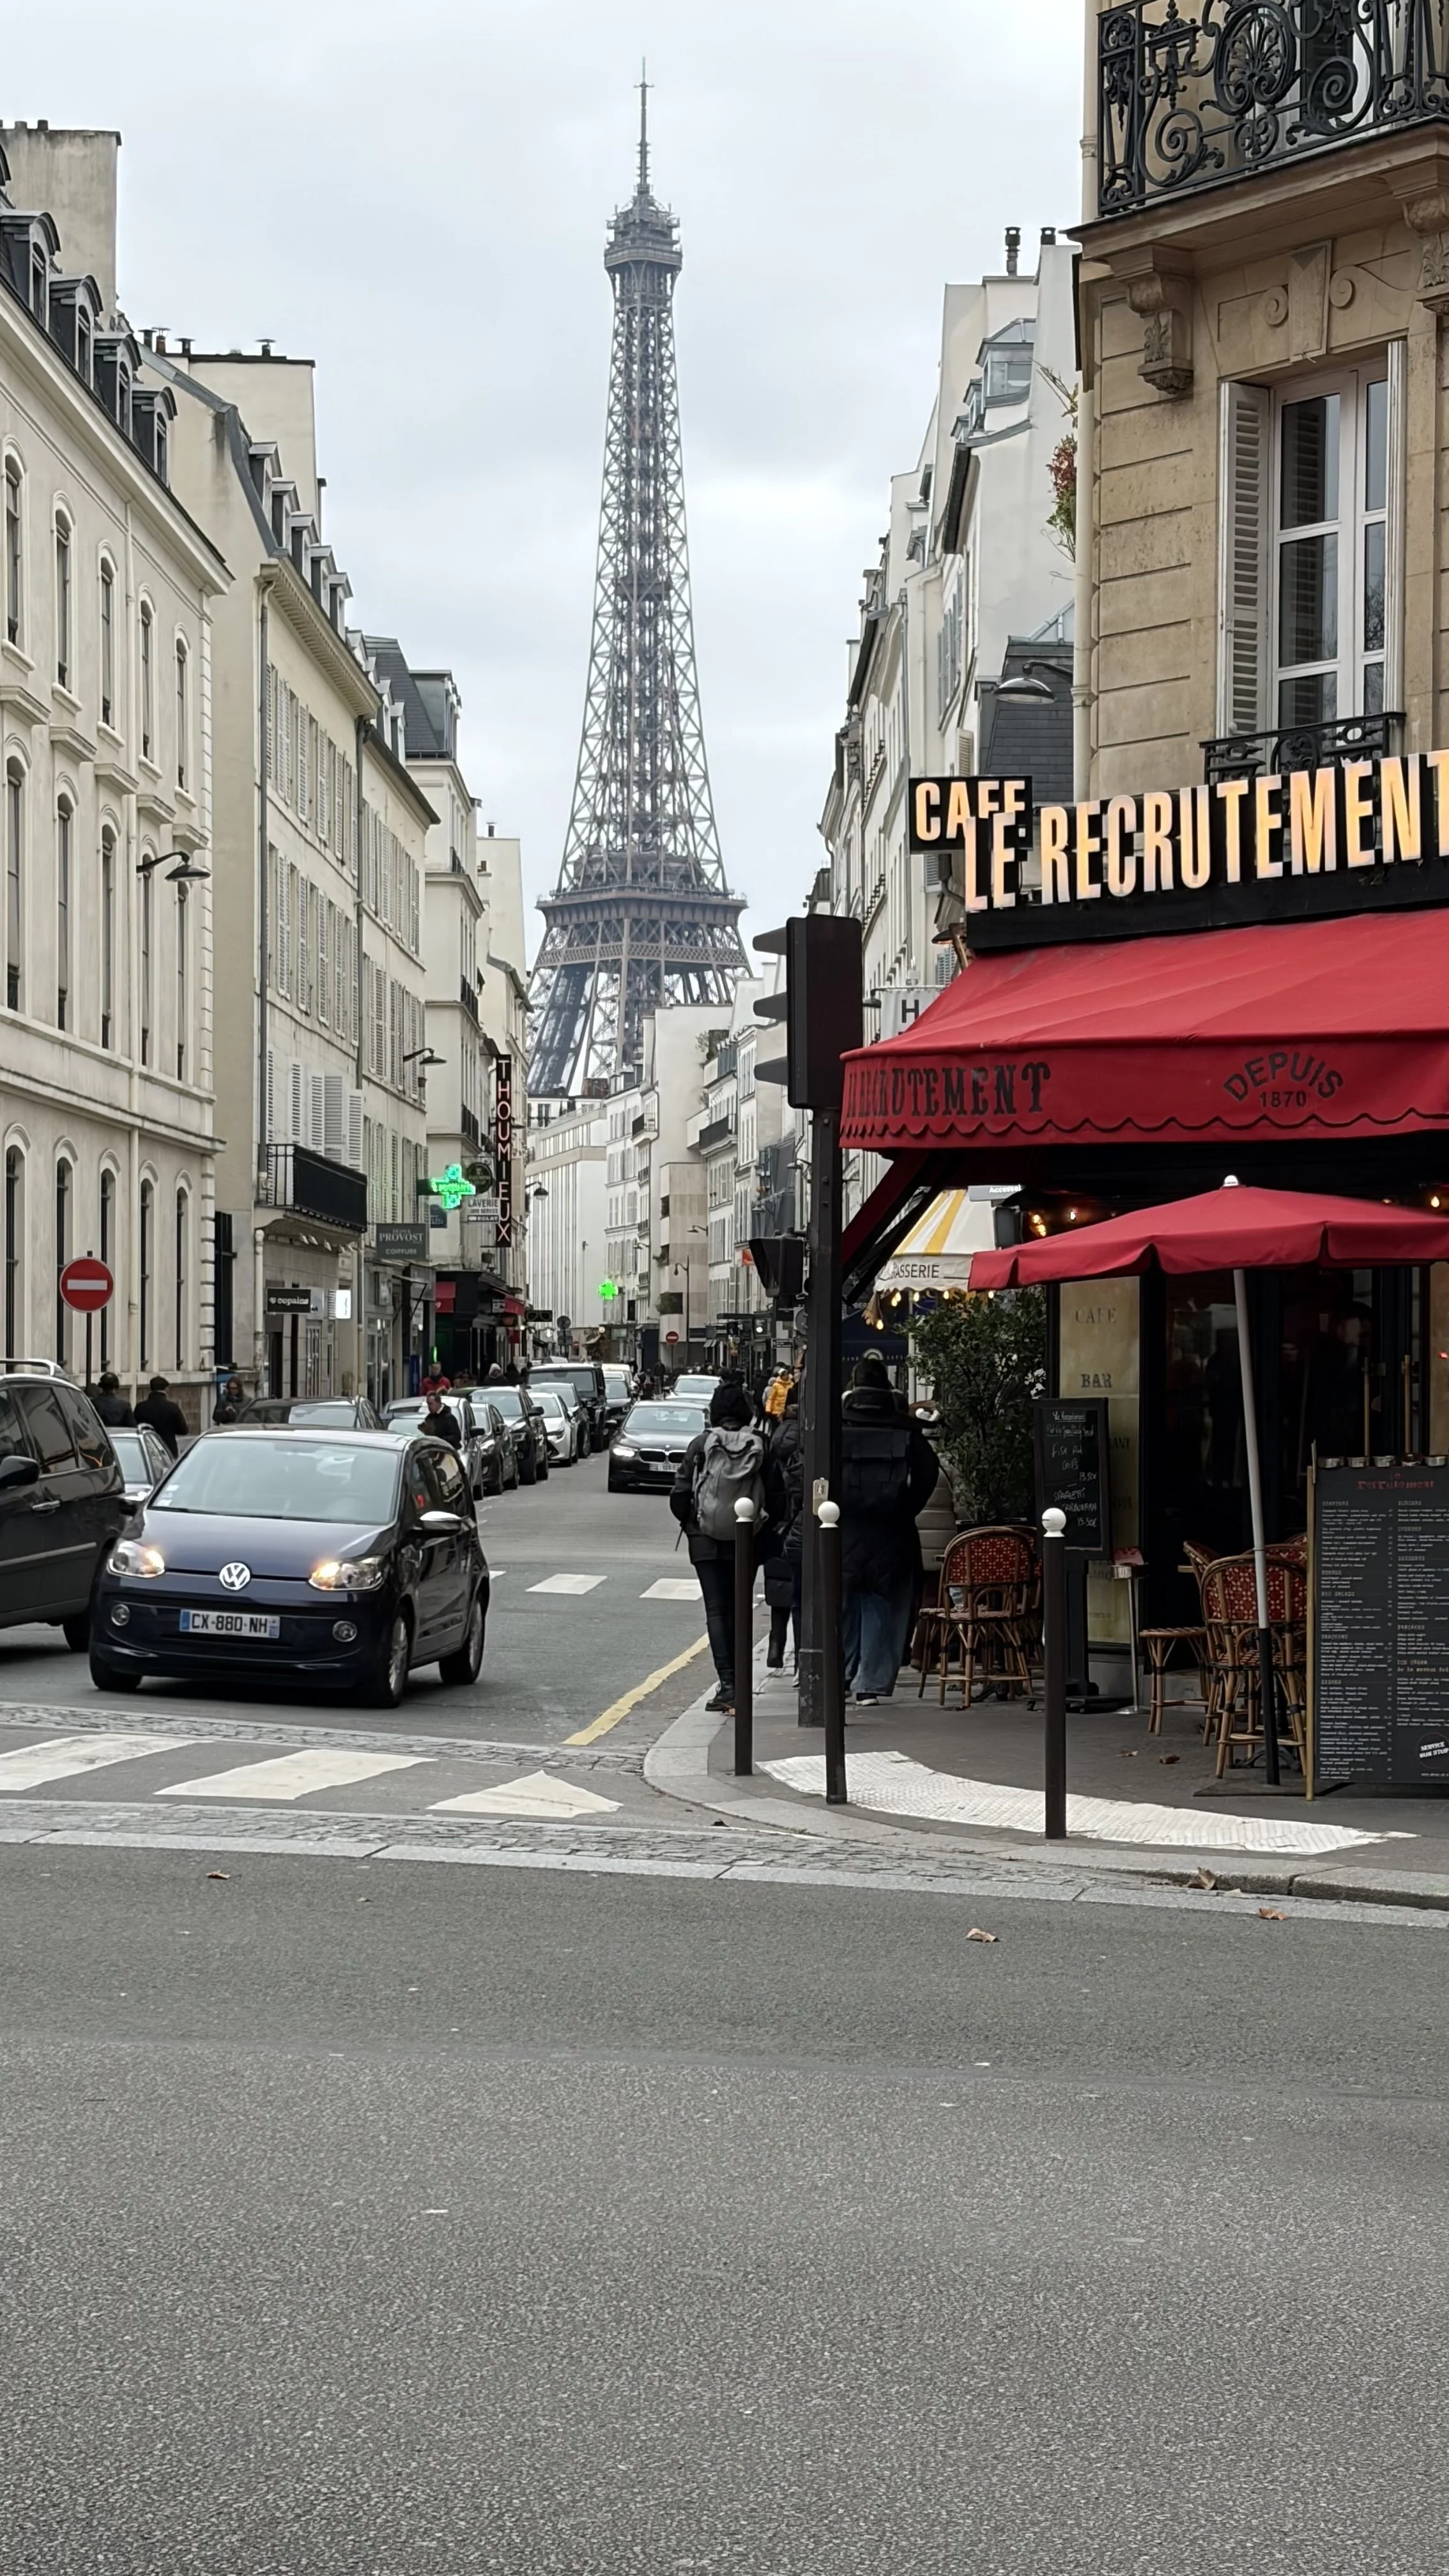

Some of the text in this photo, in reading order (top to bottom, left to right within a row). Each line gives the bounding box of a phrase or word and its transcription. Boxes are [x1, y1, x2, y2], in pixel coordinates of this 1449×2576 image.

[965, 749, 1449, 912] LE RECRUTEMENT
[1223, 1051, 1344, 1102] DEPUIS
[1259, 1091, 1307, 1108] 1870
[497, 1059, 510, 1243] THOUMIEUX
[468, 1199, 498, 1207] LAVERIE
[379, 1232, 424, 1242] PROVOST
[277, 1296, 309, 1306] copains
[1081, 1374, 1112, 1388] BAR
[1420, 1741, 1445, 1751] SERVICE
